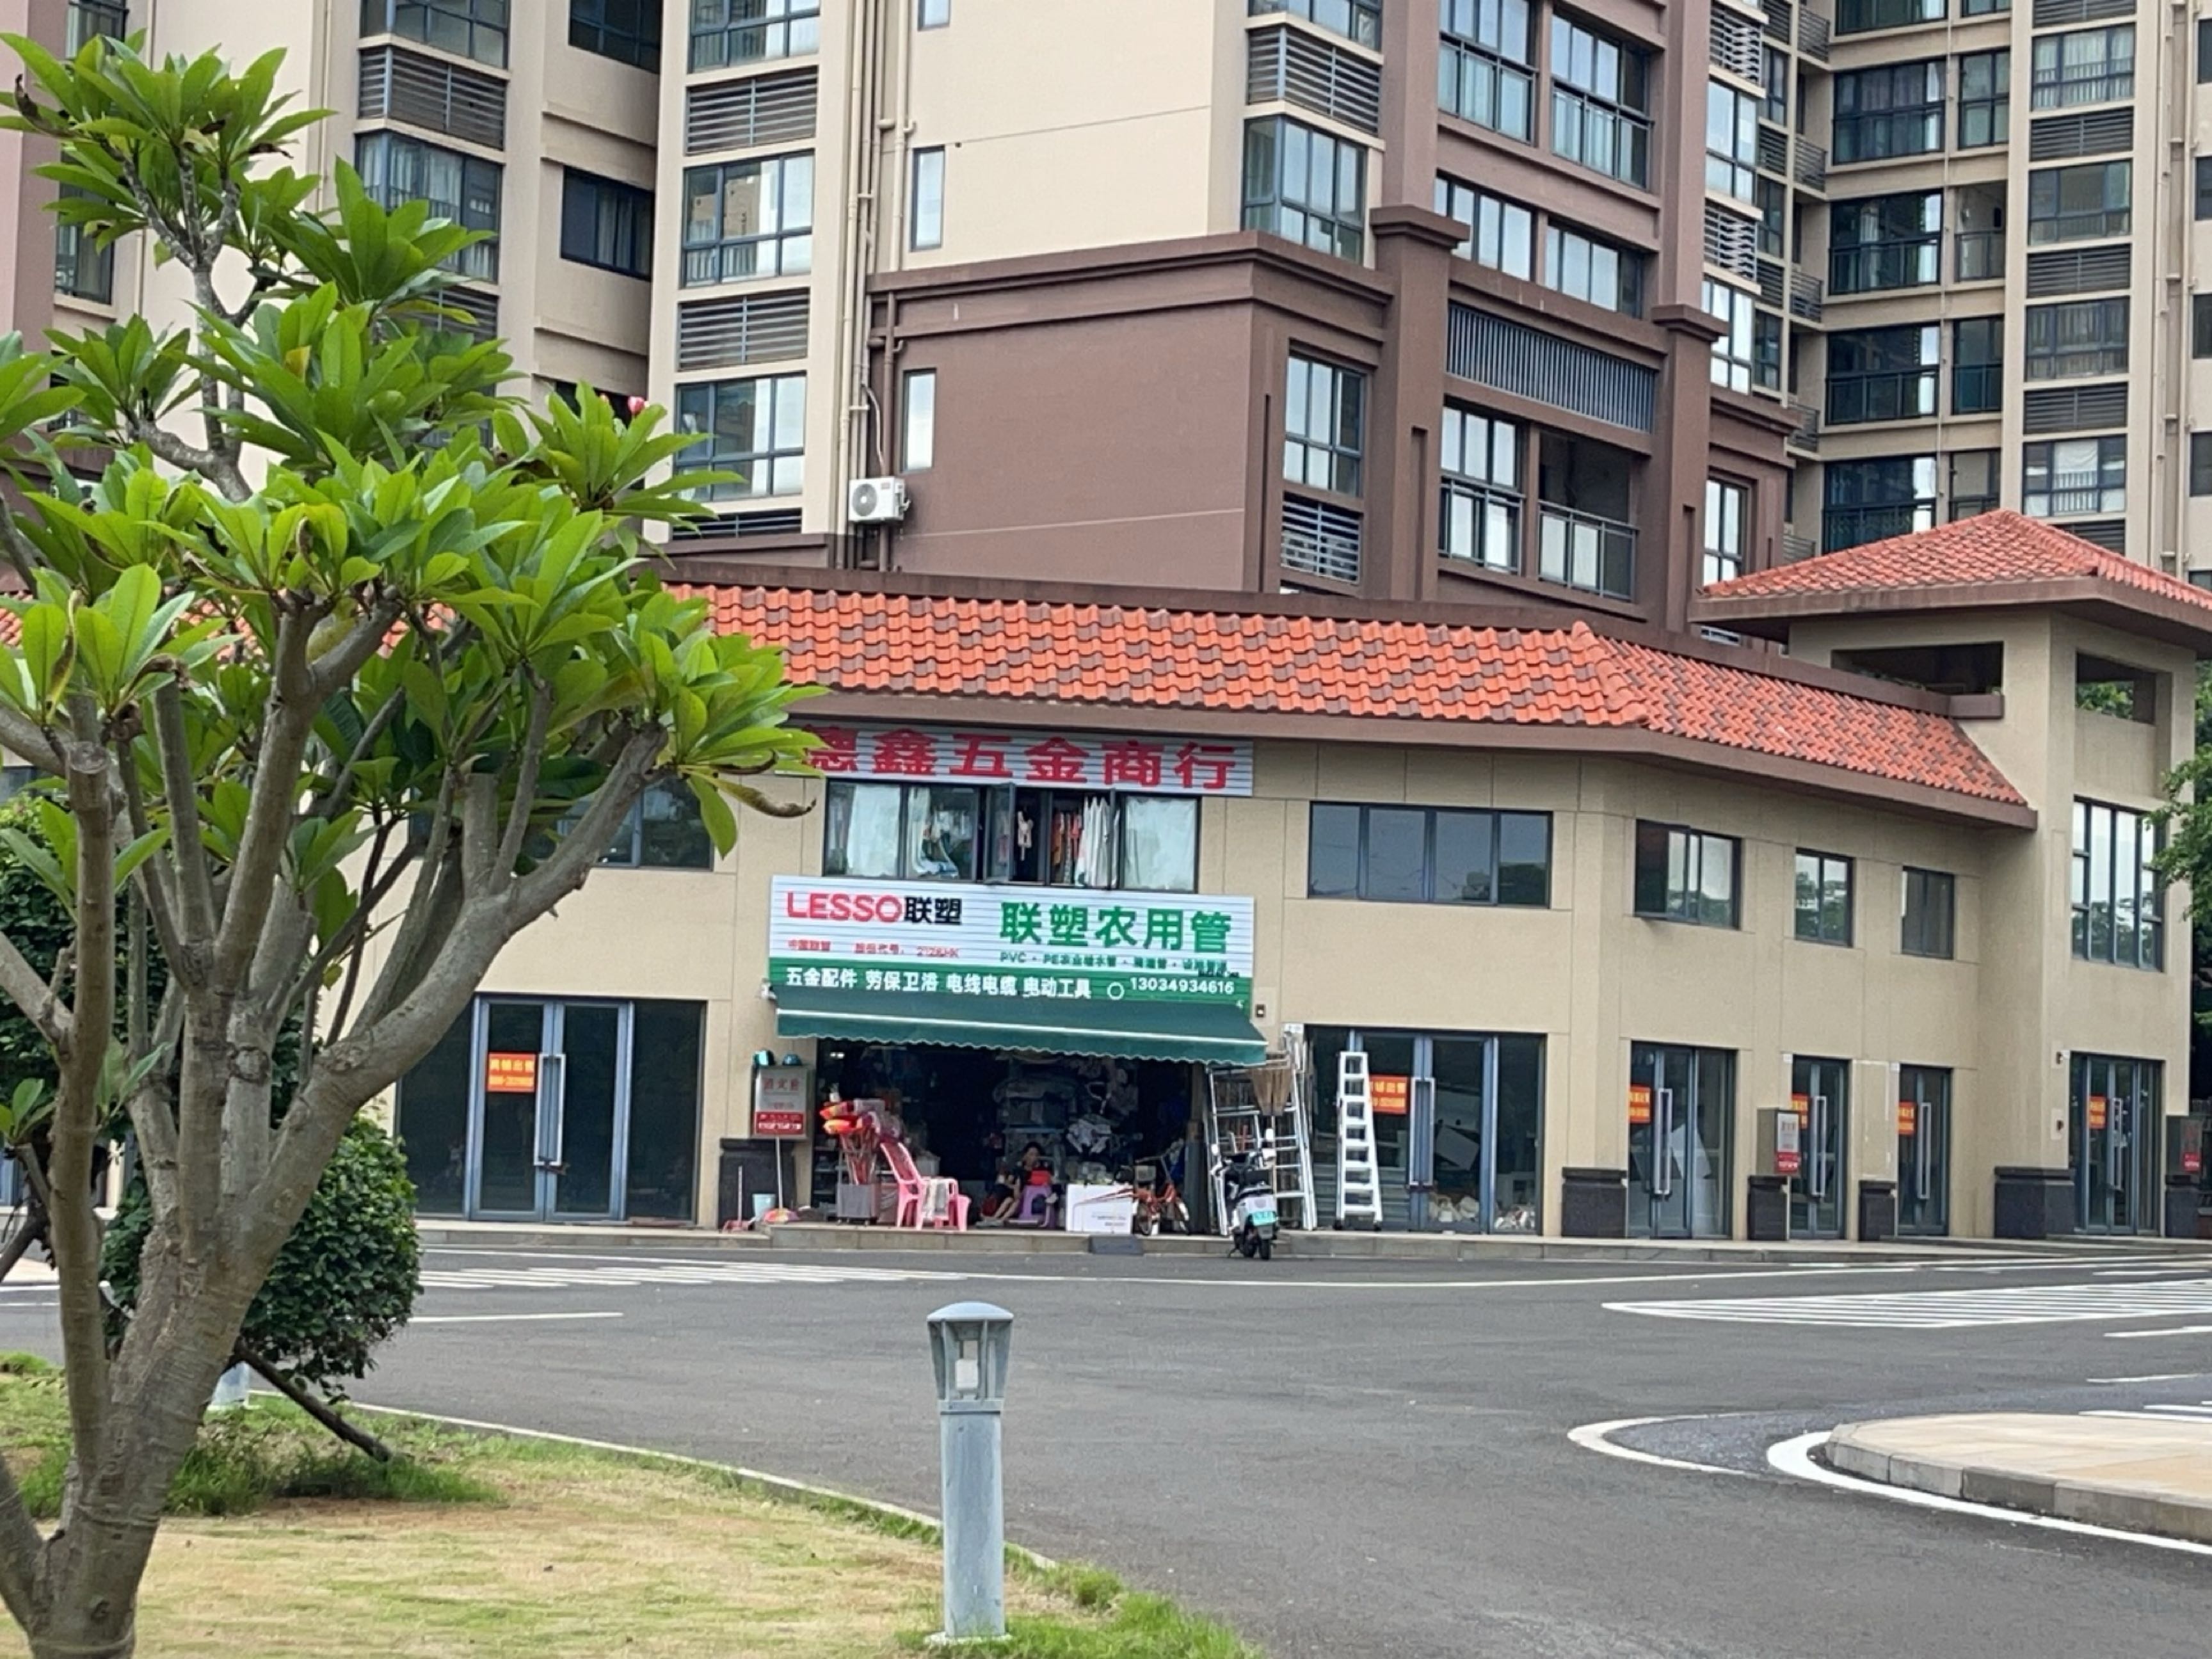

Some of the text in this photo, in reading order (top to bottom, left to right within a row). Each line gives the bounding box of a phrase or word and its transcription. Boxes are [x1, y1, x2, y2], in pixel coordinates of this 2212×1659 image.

[787, 892, 902, 923] LESSO
[904, 896, 963, 926] 联塑
[1000, 901, 1231, 954] 联塑农用管
[786, 966, 1235, 999] 五金配件 劳保卫浴 电线电缆 电动工具 13034934616
